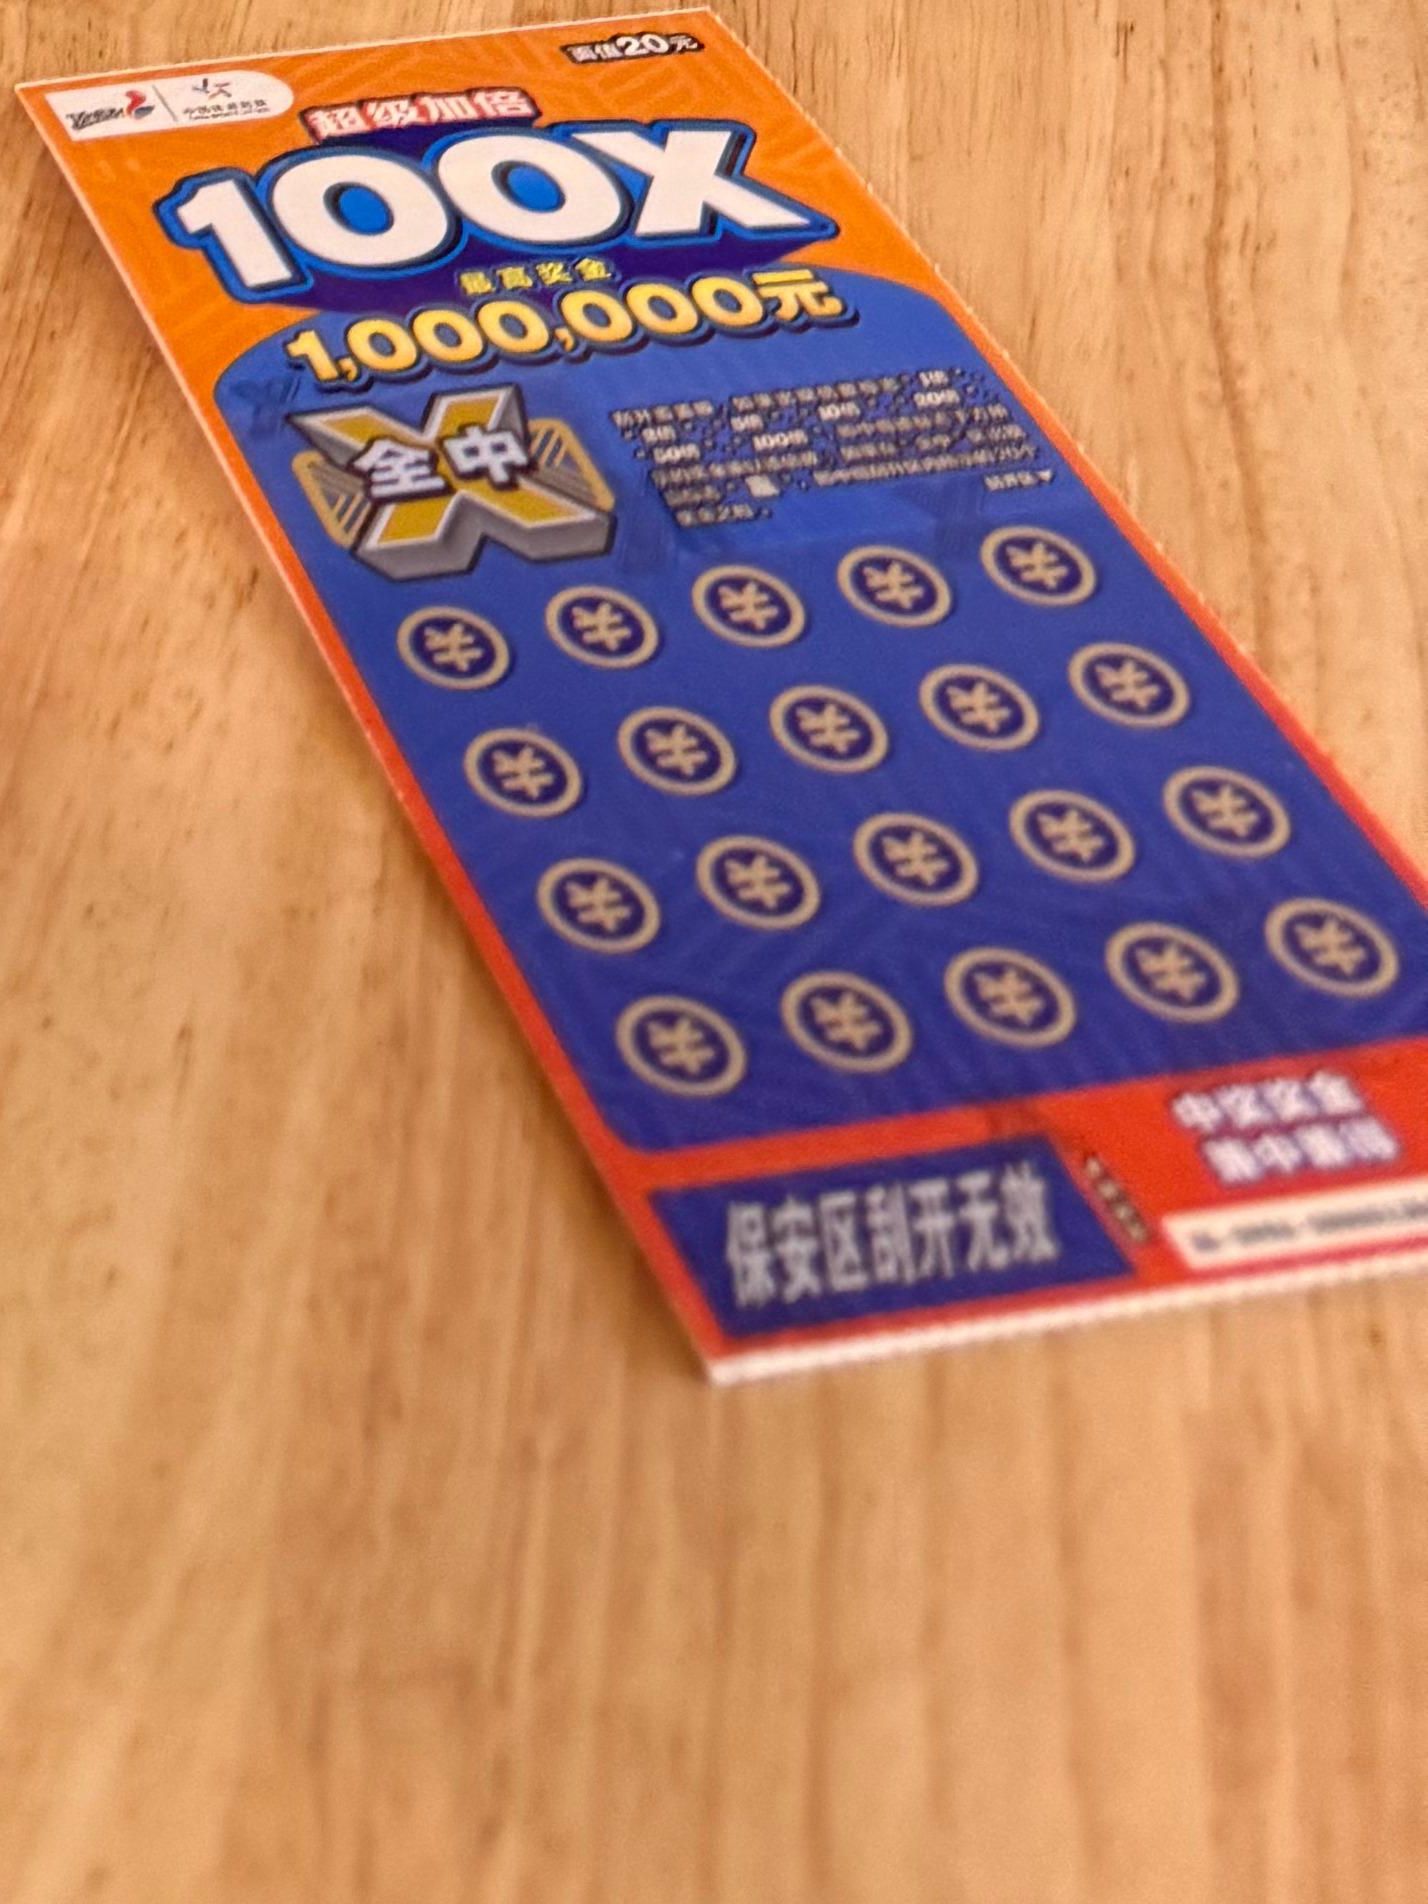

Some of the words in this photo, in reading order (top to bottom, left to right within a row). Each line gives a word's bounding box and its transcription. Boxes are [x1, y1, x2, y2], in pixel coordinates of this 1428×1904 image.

[569, 32, 701, 63] 面值20元
[309, 88, 537, 145] 超级加倍
[174, 128, 811, 290] 100X
[459, 257, 613, 295] 最高奖金
[286, 267, 844, 383] 1,000,000元
[352, 420, 532, 499] 全中
[726, 1160, 1061, 1310] 保安区刮开无效
